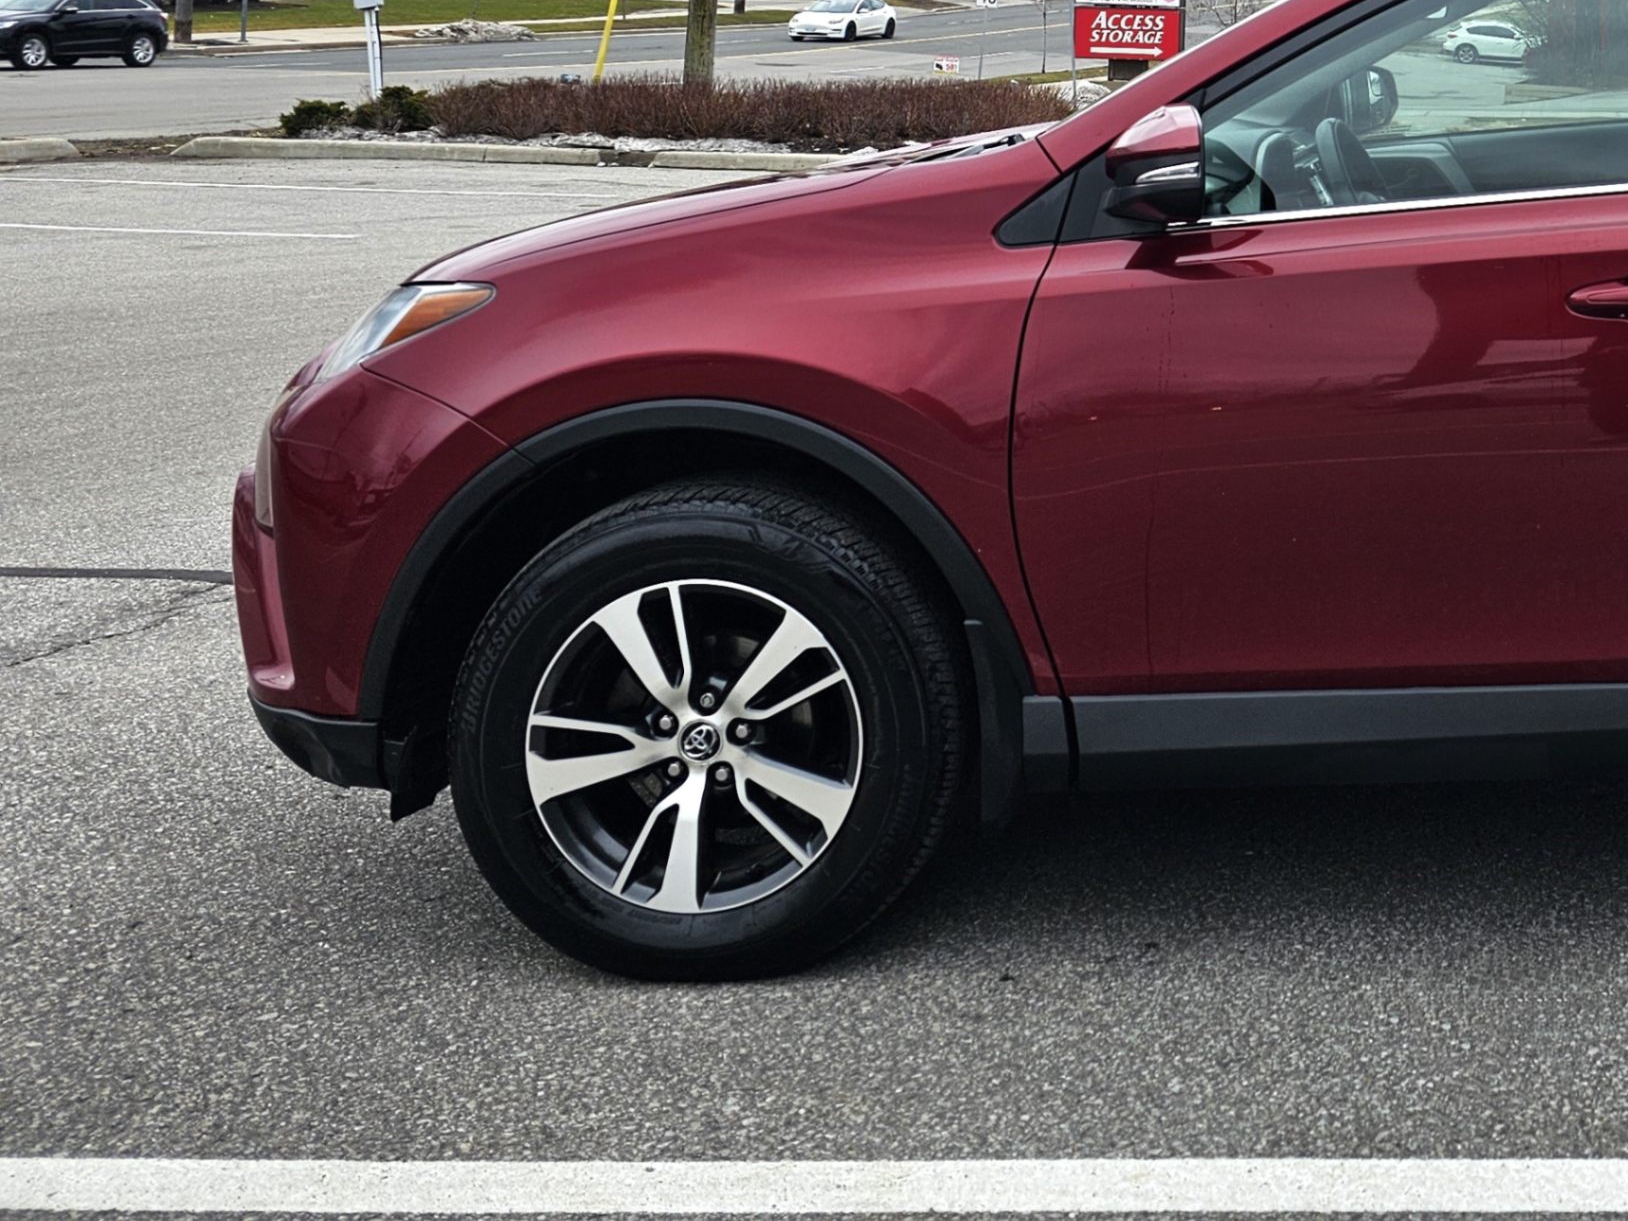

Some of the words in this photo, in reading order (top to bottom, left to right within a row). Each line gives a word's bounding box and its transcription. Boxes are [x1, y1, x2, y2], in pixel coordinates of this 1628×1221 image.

[1091, 10, 1165, 31] ACCESS
[1089, 29, 1164, 44] STORAGE
[460, 587, 543, 735] BRIDGESTONE
